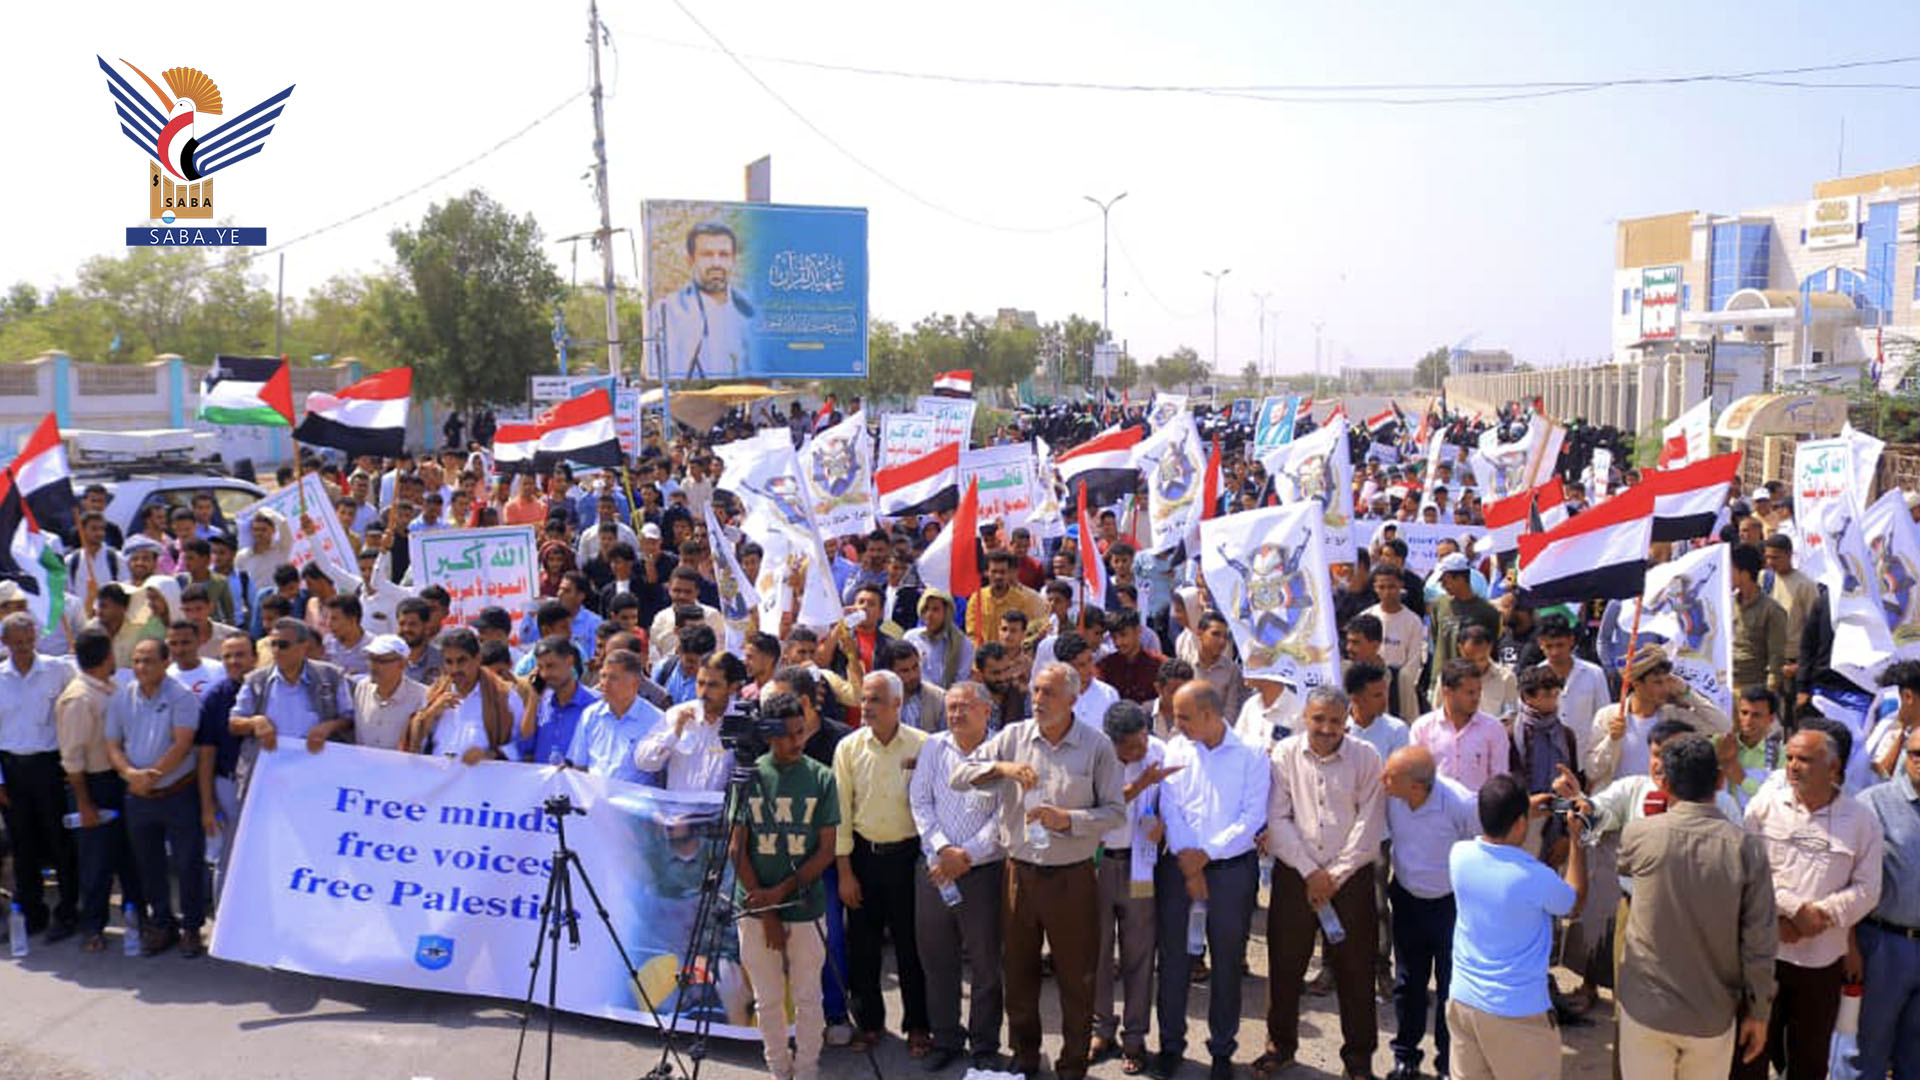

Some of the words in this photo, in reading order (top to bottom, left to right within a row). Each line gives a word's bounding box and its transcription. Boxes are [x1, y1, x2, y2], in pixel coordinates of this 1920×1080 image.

[490, 541, 525, 567] الله
[331, 786, 427, 822] Free
[439, 800, 561, 835] minds
[336, 831, 418, 864] free
[432, 845, 555, 880] voices
[289, 867, 375, 902] free
